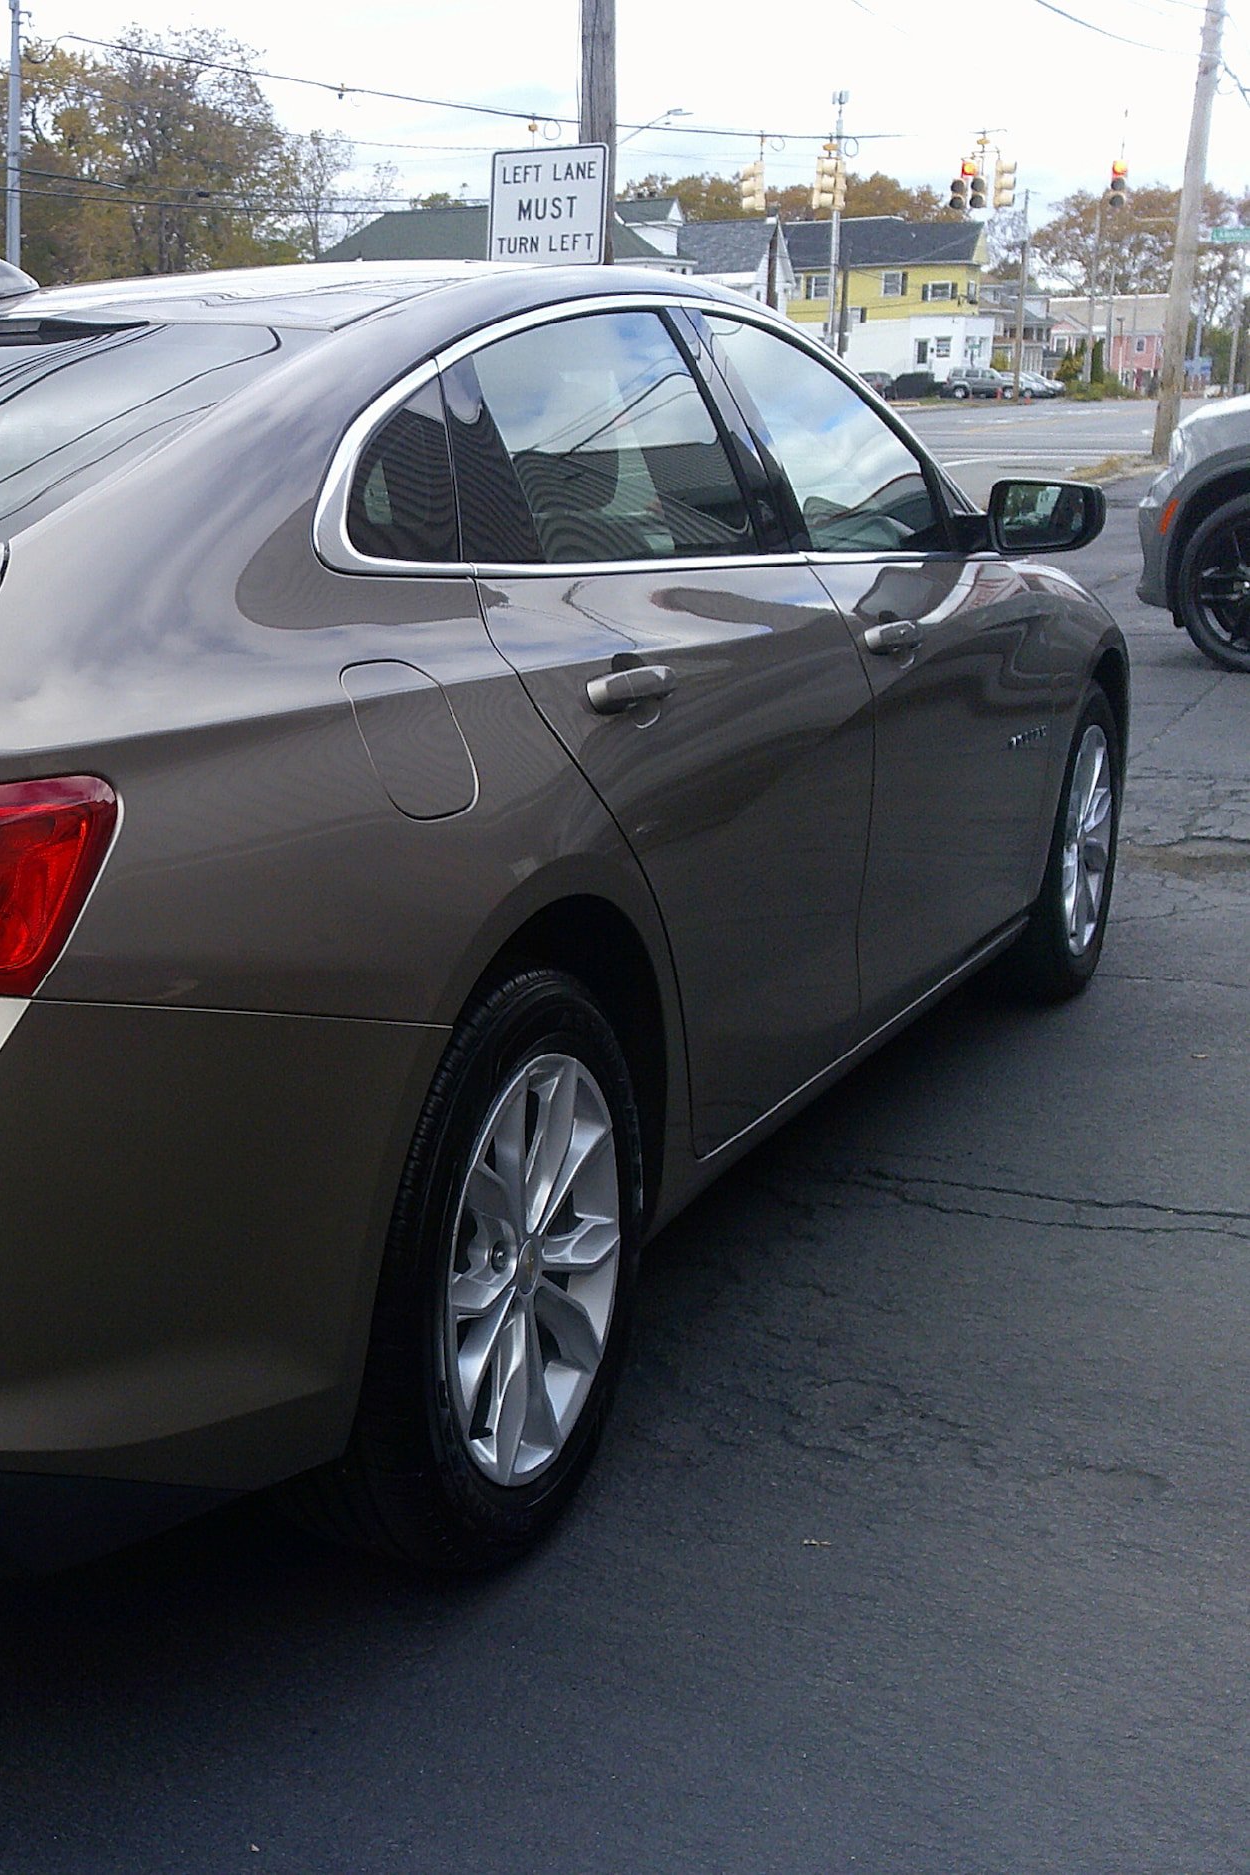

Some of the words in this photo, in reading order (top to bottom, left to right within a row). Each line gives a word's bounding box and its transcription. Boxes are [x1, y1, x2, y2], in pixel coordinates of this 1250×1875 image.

[502, 164, 543, 184] LEFT
[553, 161, 597, 181] LANE
[517, 196, 578, 221] MUST
[497, 236, 540, 254] TURN
[549, 233, 595, 252] LEFT
